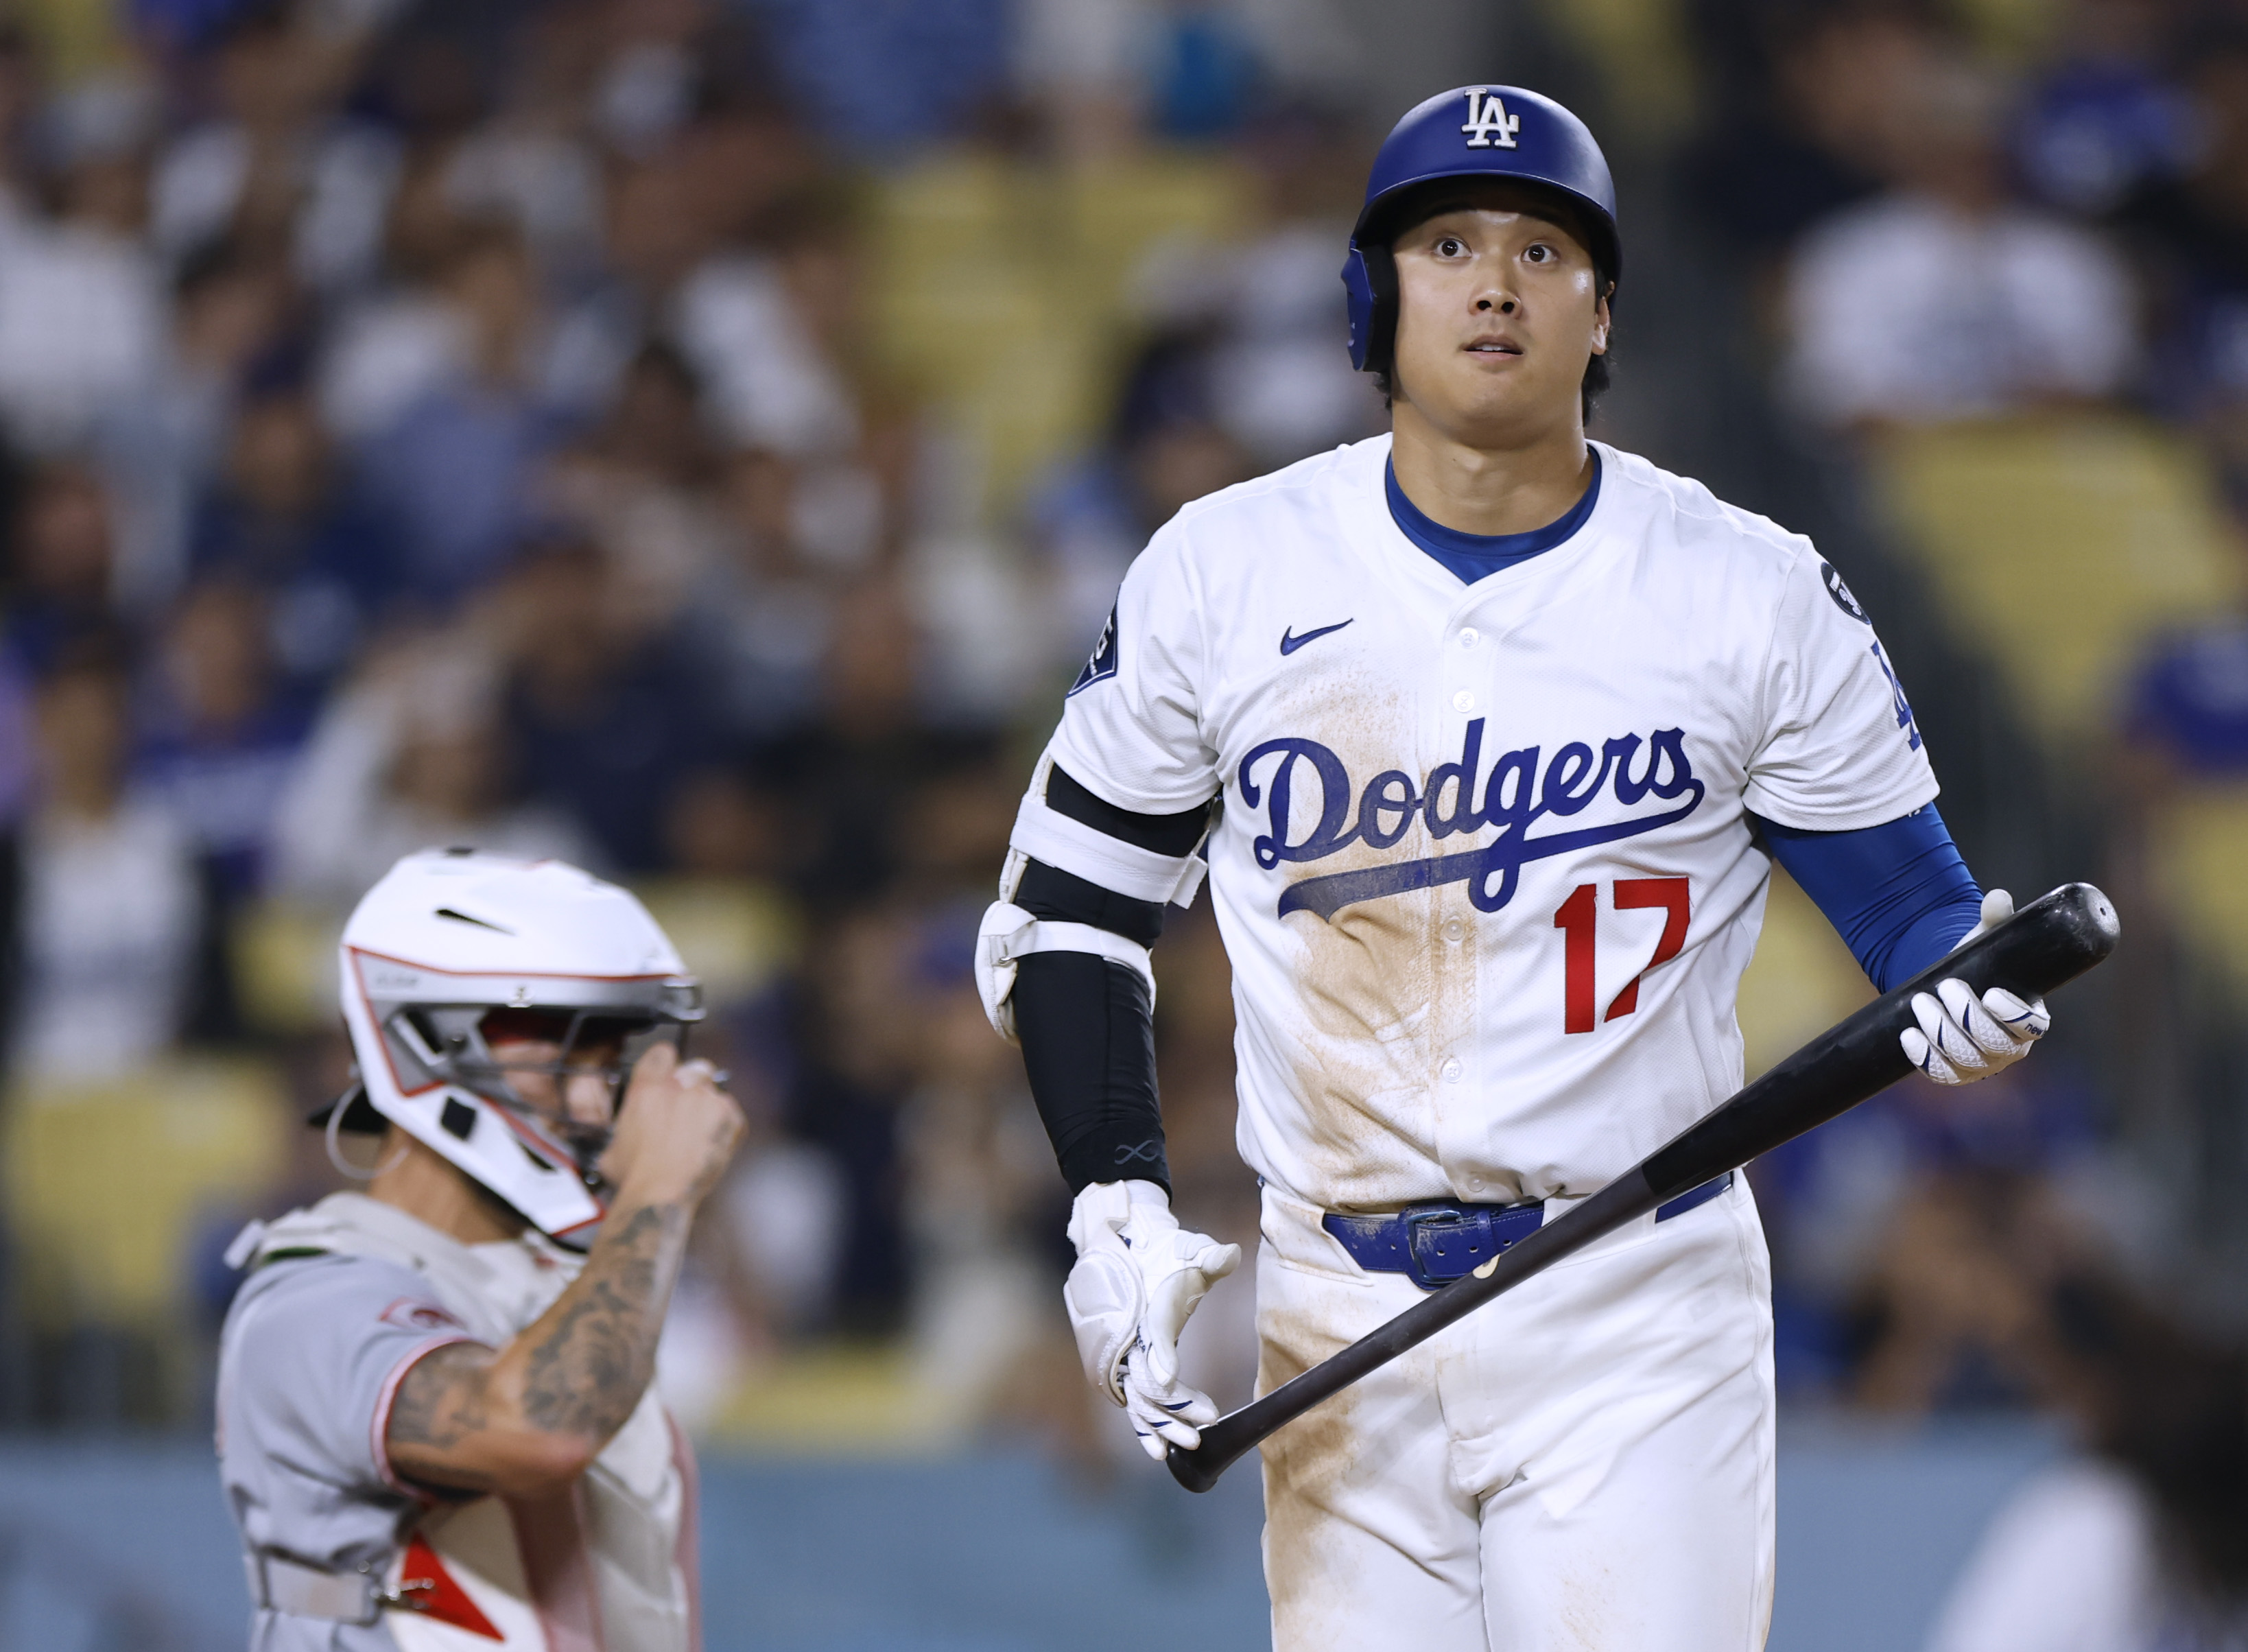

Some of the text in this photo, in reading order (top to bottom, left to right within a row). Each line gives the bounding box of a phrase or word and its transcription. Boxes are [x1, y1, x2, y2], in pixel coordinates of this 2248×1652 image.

[1461, 88, 1519, 146] LA
[1238, 718, 1705, 919] Dodgers
[1553, 877, 1690, 1035] 17
